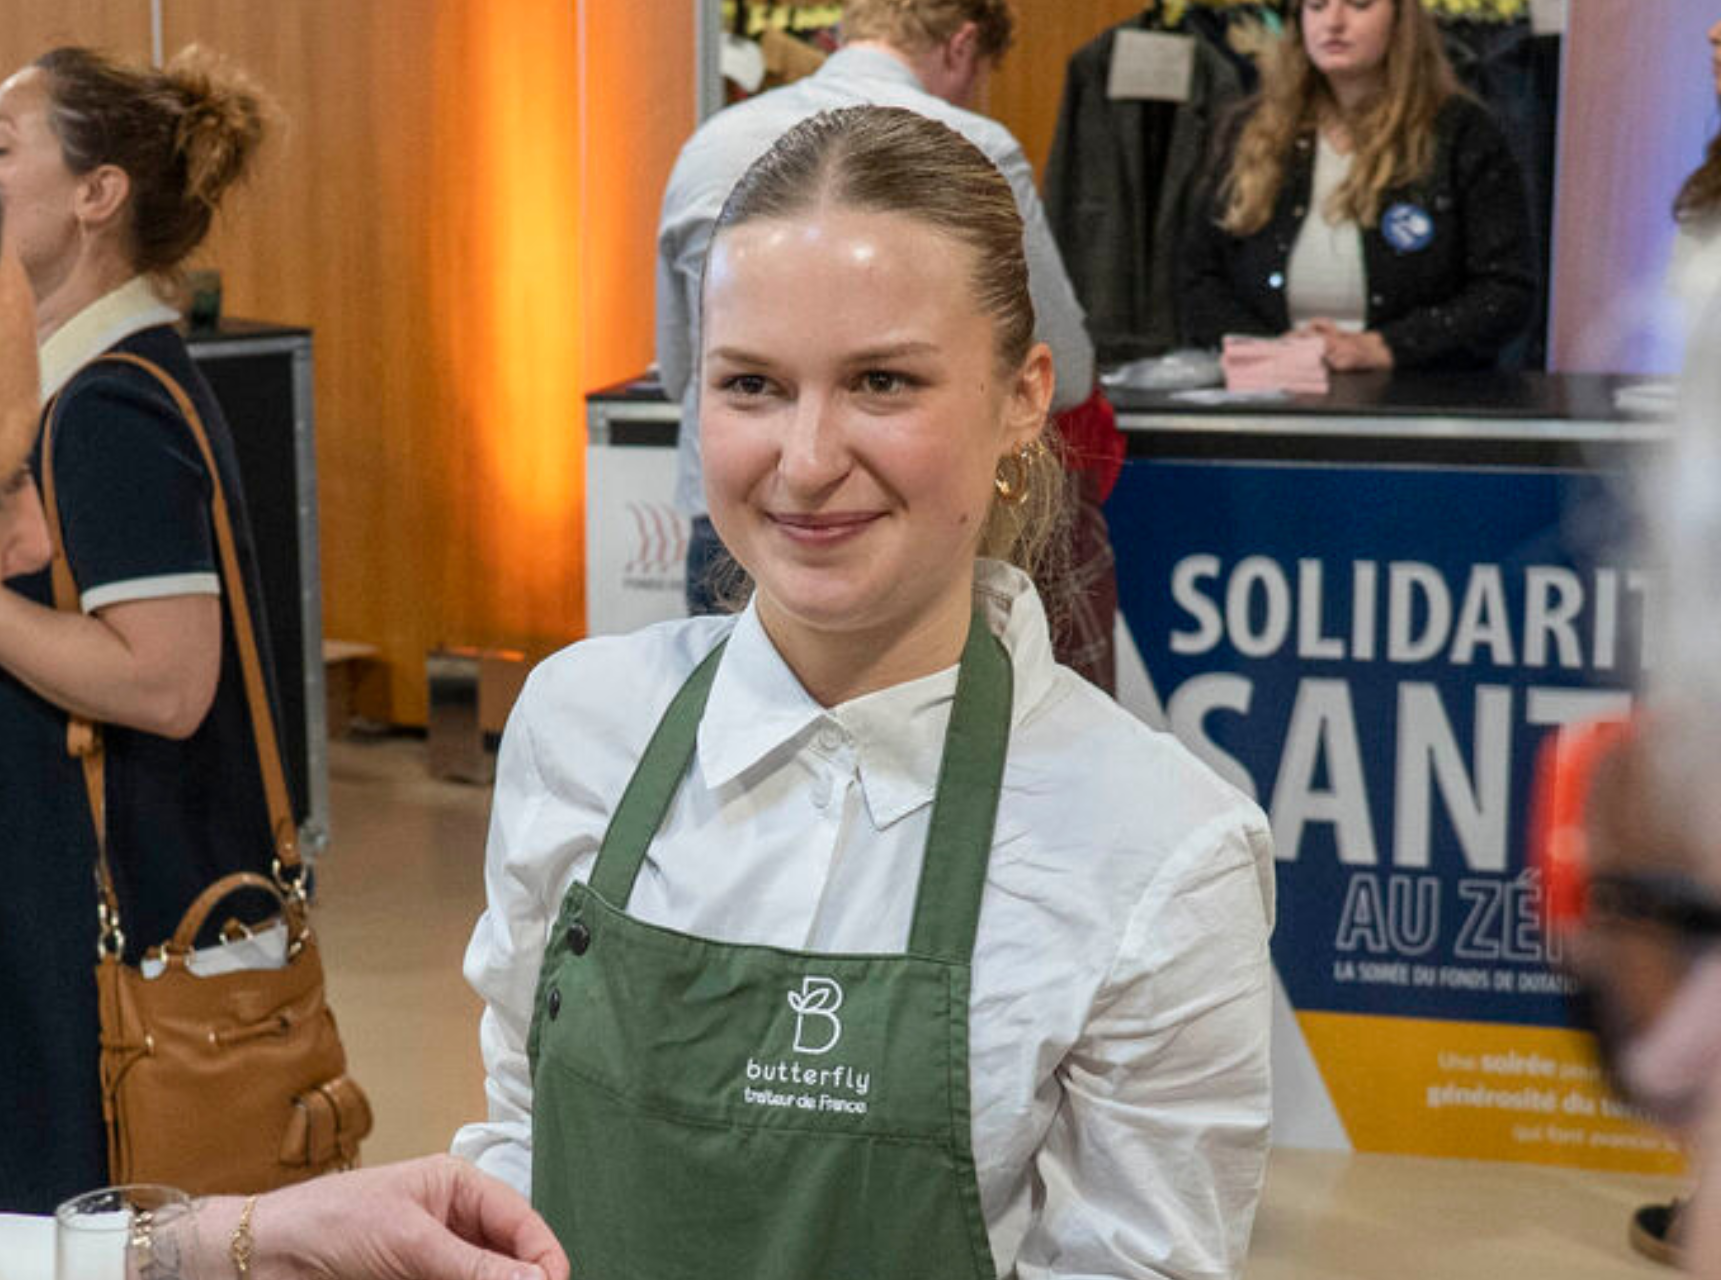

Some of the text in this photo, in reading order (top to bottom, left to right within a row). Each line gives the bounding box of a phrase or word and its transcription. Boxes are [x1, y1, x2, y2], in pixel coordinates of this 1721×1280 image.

[1169, 553, 1656, 670] SOLIDARIT
[1167, 672, 1633, 872] SANT
[1335, 872, 1440, 956] AU
[1333, 960, 1355, 981] LA
[1357, 960, 1410, 986] SOIRÉE
[1412, 964, 1437, 987] DU
[1440, 966, 1490, 990] FONDS
[1493, 970, 1515, 992] DE
[746, 1057, 870, 1096] butterfly
[1480, 1050, 1556, 1076] soirée
[796, 1093, 816, 1110] de
[818, 1094, 868, 1113] France
[1427, 1081, 1556, 1114] générosité
[1561, 1089, 1597, 1116] du
